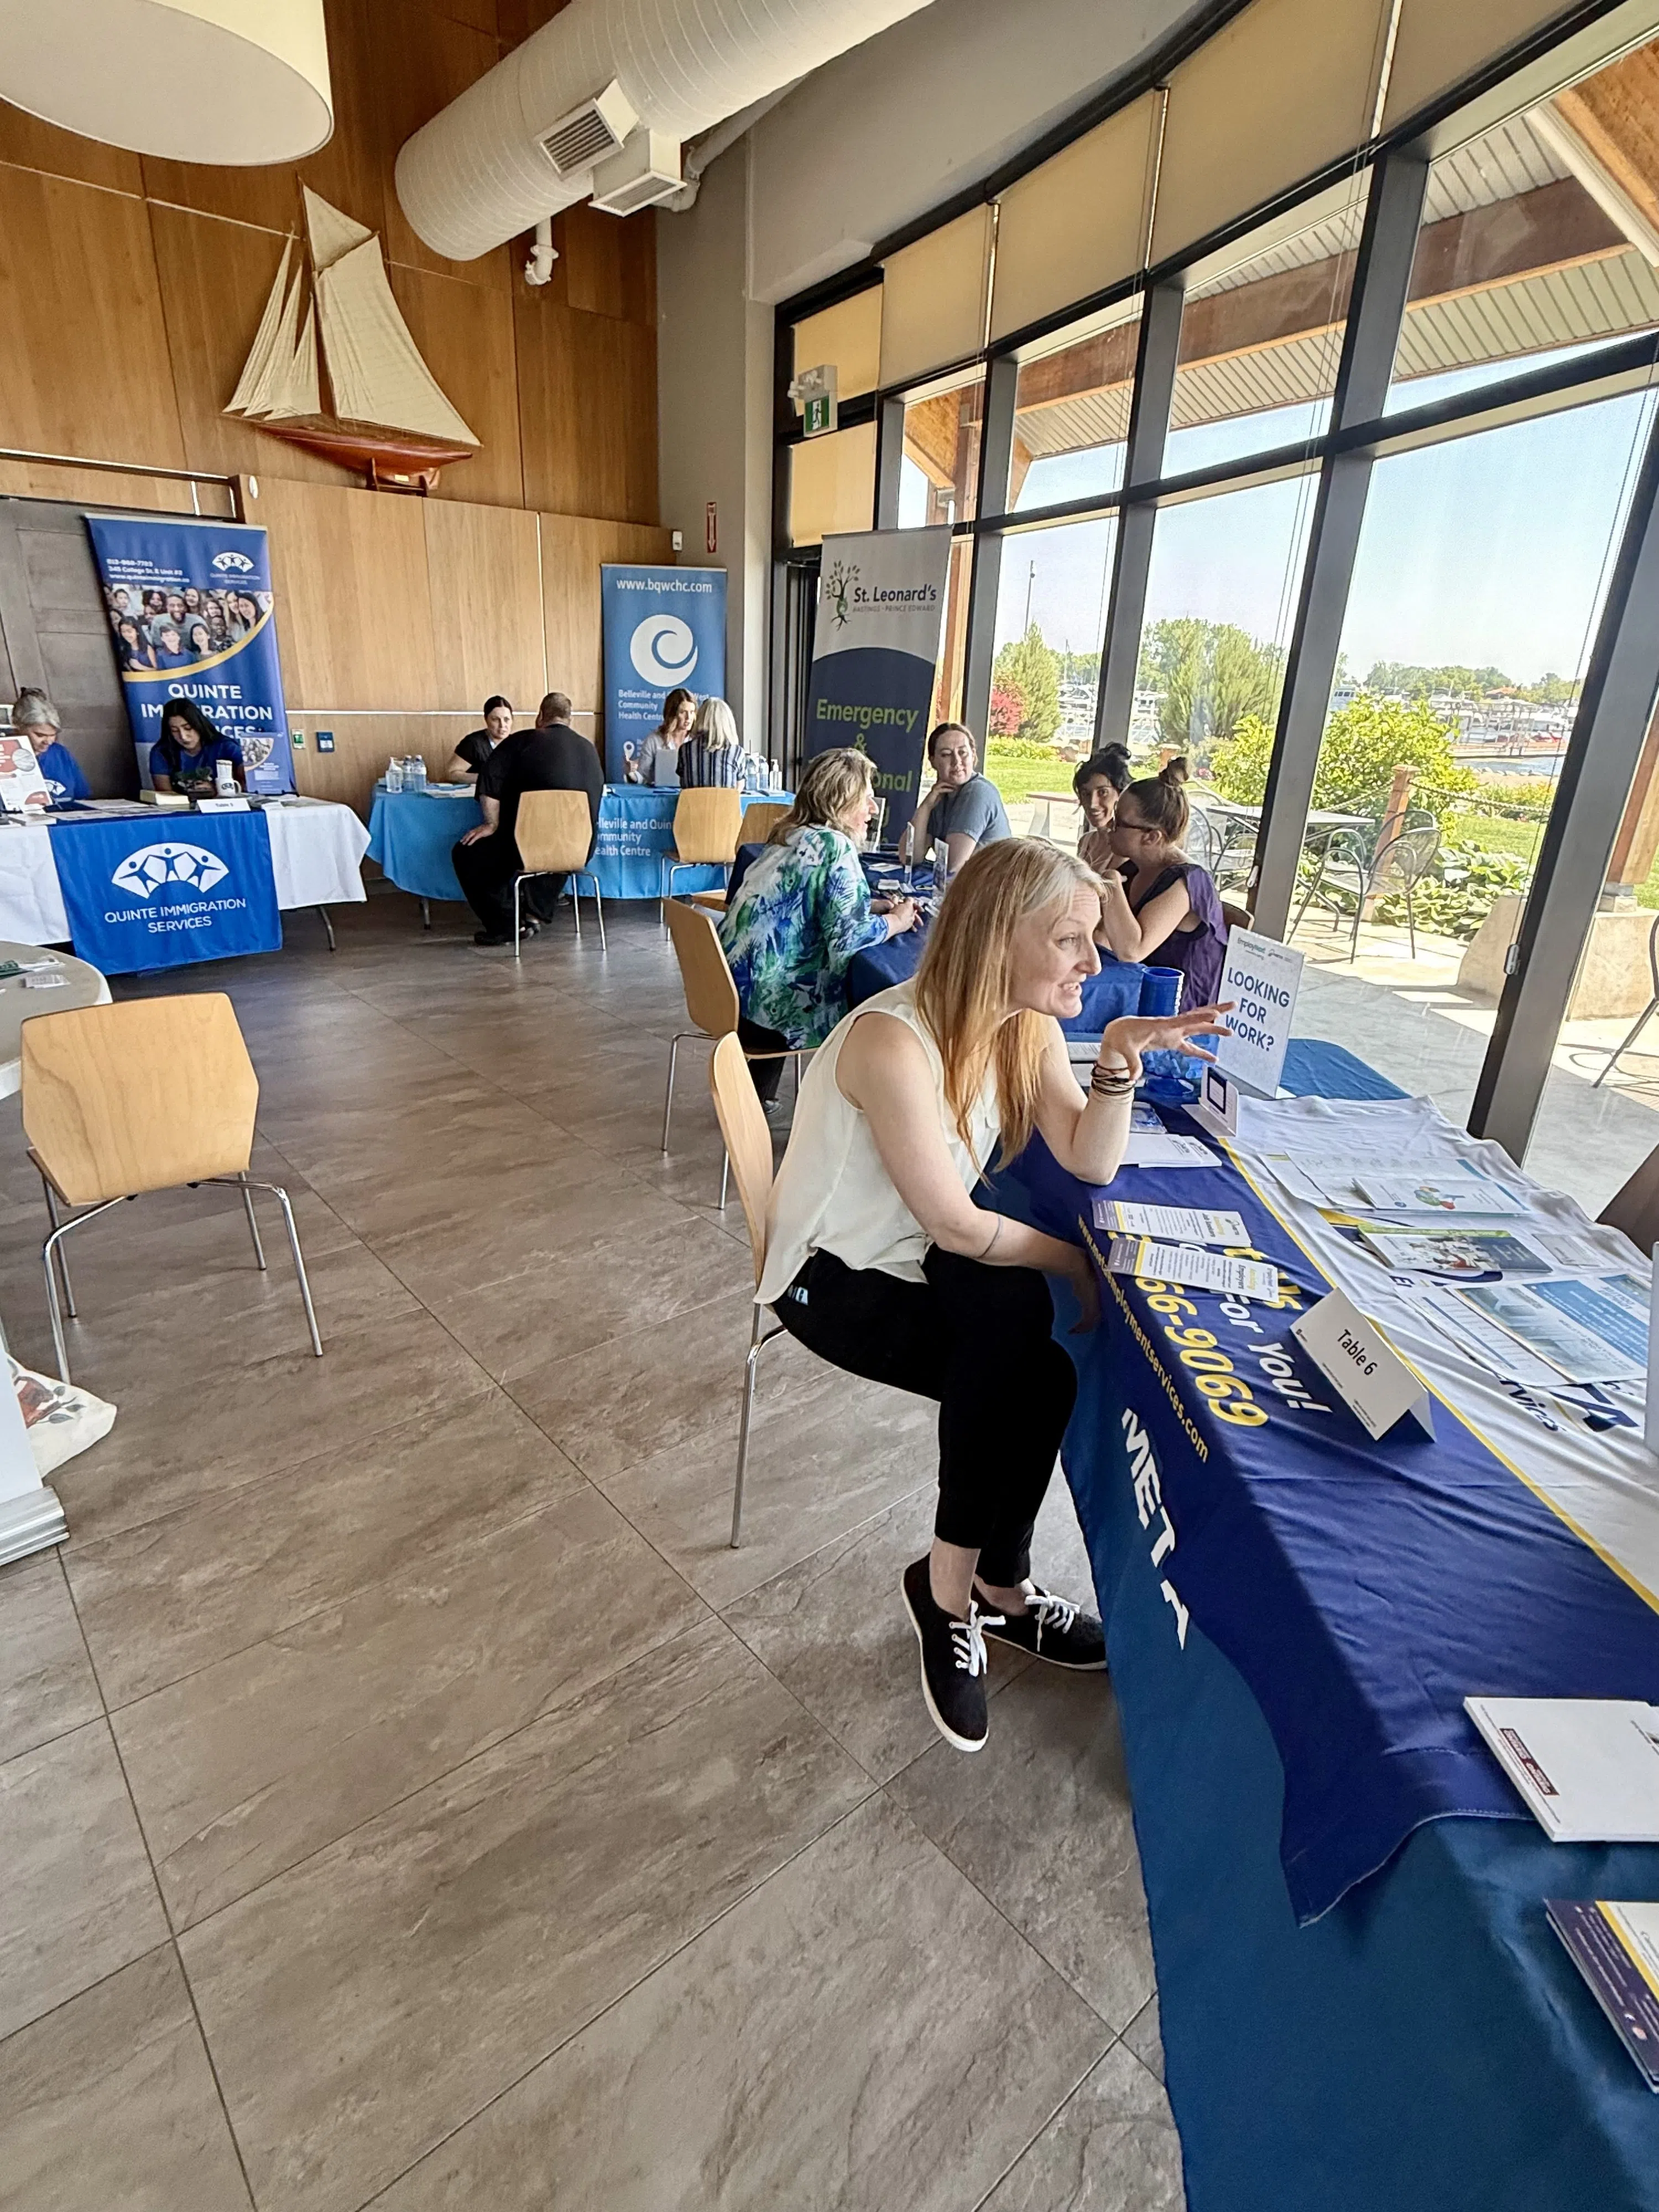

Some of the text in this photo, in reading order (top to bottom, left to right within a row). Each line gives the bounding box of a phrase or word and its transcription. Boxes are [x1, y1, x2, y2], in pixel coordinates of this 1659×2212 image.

[617, 578, 712, 594] www.bqwchc.com
[853, 583, 937, 602] St. Leonard's
[168, 684, 243, 700] QUINTE
[618, 689, 651, 699] Belleville
[652, 690, 665, 699] and
[141, 703, 273, 720] IMRATION
[618, 700, 658, 711] Community
[816, 698, 919, 733] Emergency
[854, 733, 867, 751] &
[597, 817, 672, 830] lleville and Quin
[597, 831, 642, 845] mmunity
[595, 844, 651, 856] ealth Centre
[104, 898, 246, 924] QUINTE IMMIGRATION
[148, 916, 212, 933] SERVICES
[1227, 967, 1290, 1008] LOOKING
[1239, 997, 1267, 1024] FOR
[1225, 1014, 1274, 1052] WORK?
[1337, 1328, 1366, 1366] Table
[1364, 1361, 1378, 1376] 6
[1248, 1342, 1332, 1413] You!
